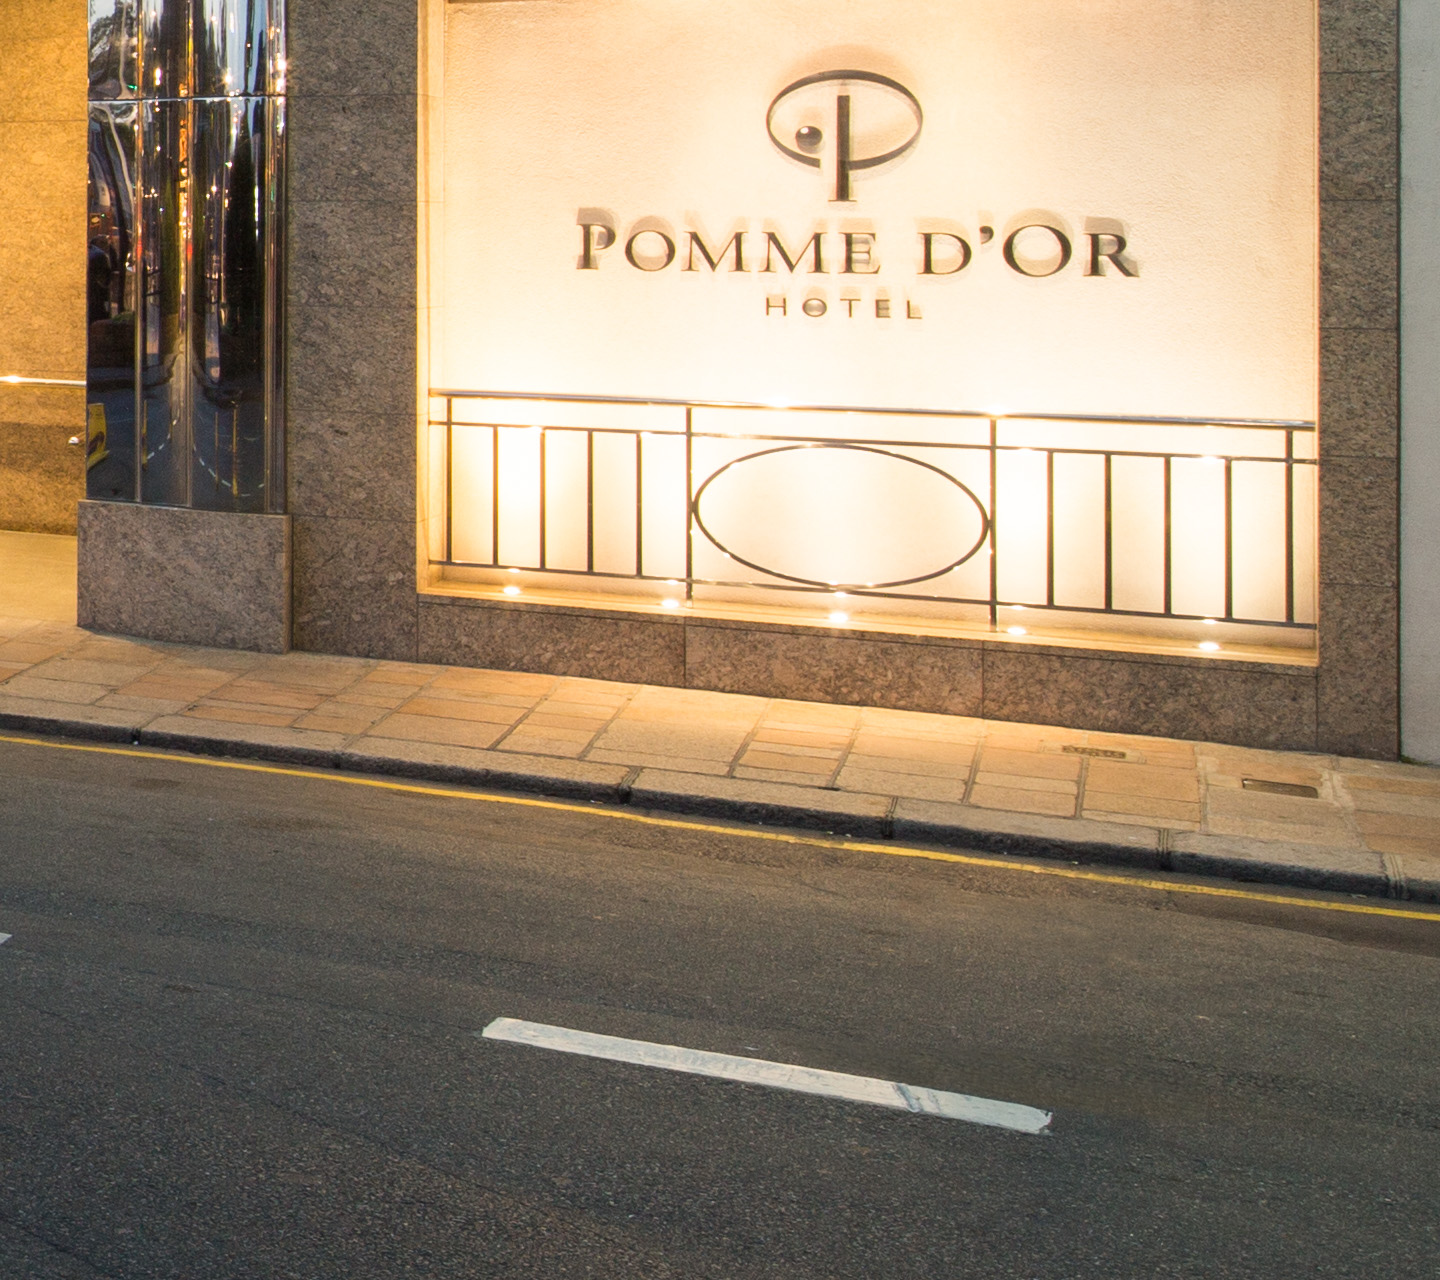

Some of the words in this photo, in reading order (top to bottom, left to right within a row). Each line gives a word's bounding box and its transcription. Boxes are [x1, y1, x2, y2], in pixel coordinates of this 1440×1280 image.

[575, 221, 881, 276] POMME
[915, 223, 1141, 279] D'OR
[765, 296, 922, 320] HOTEL
